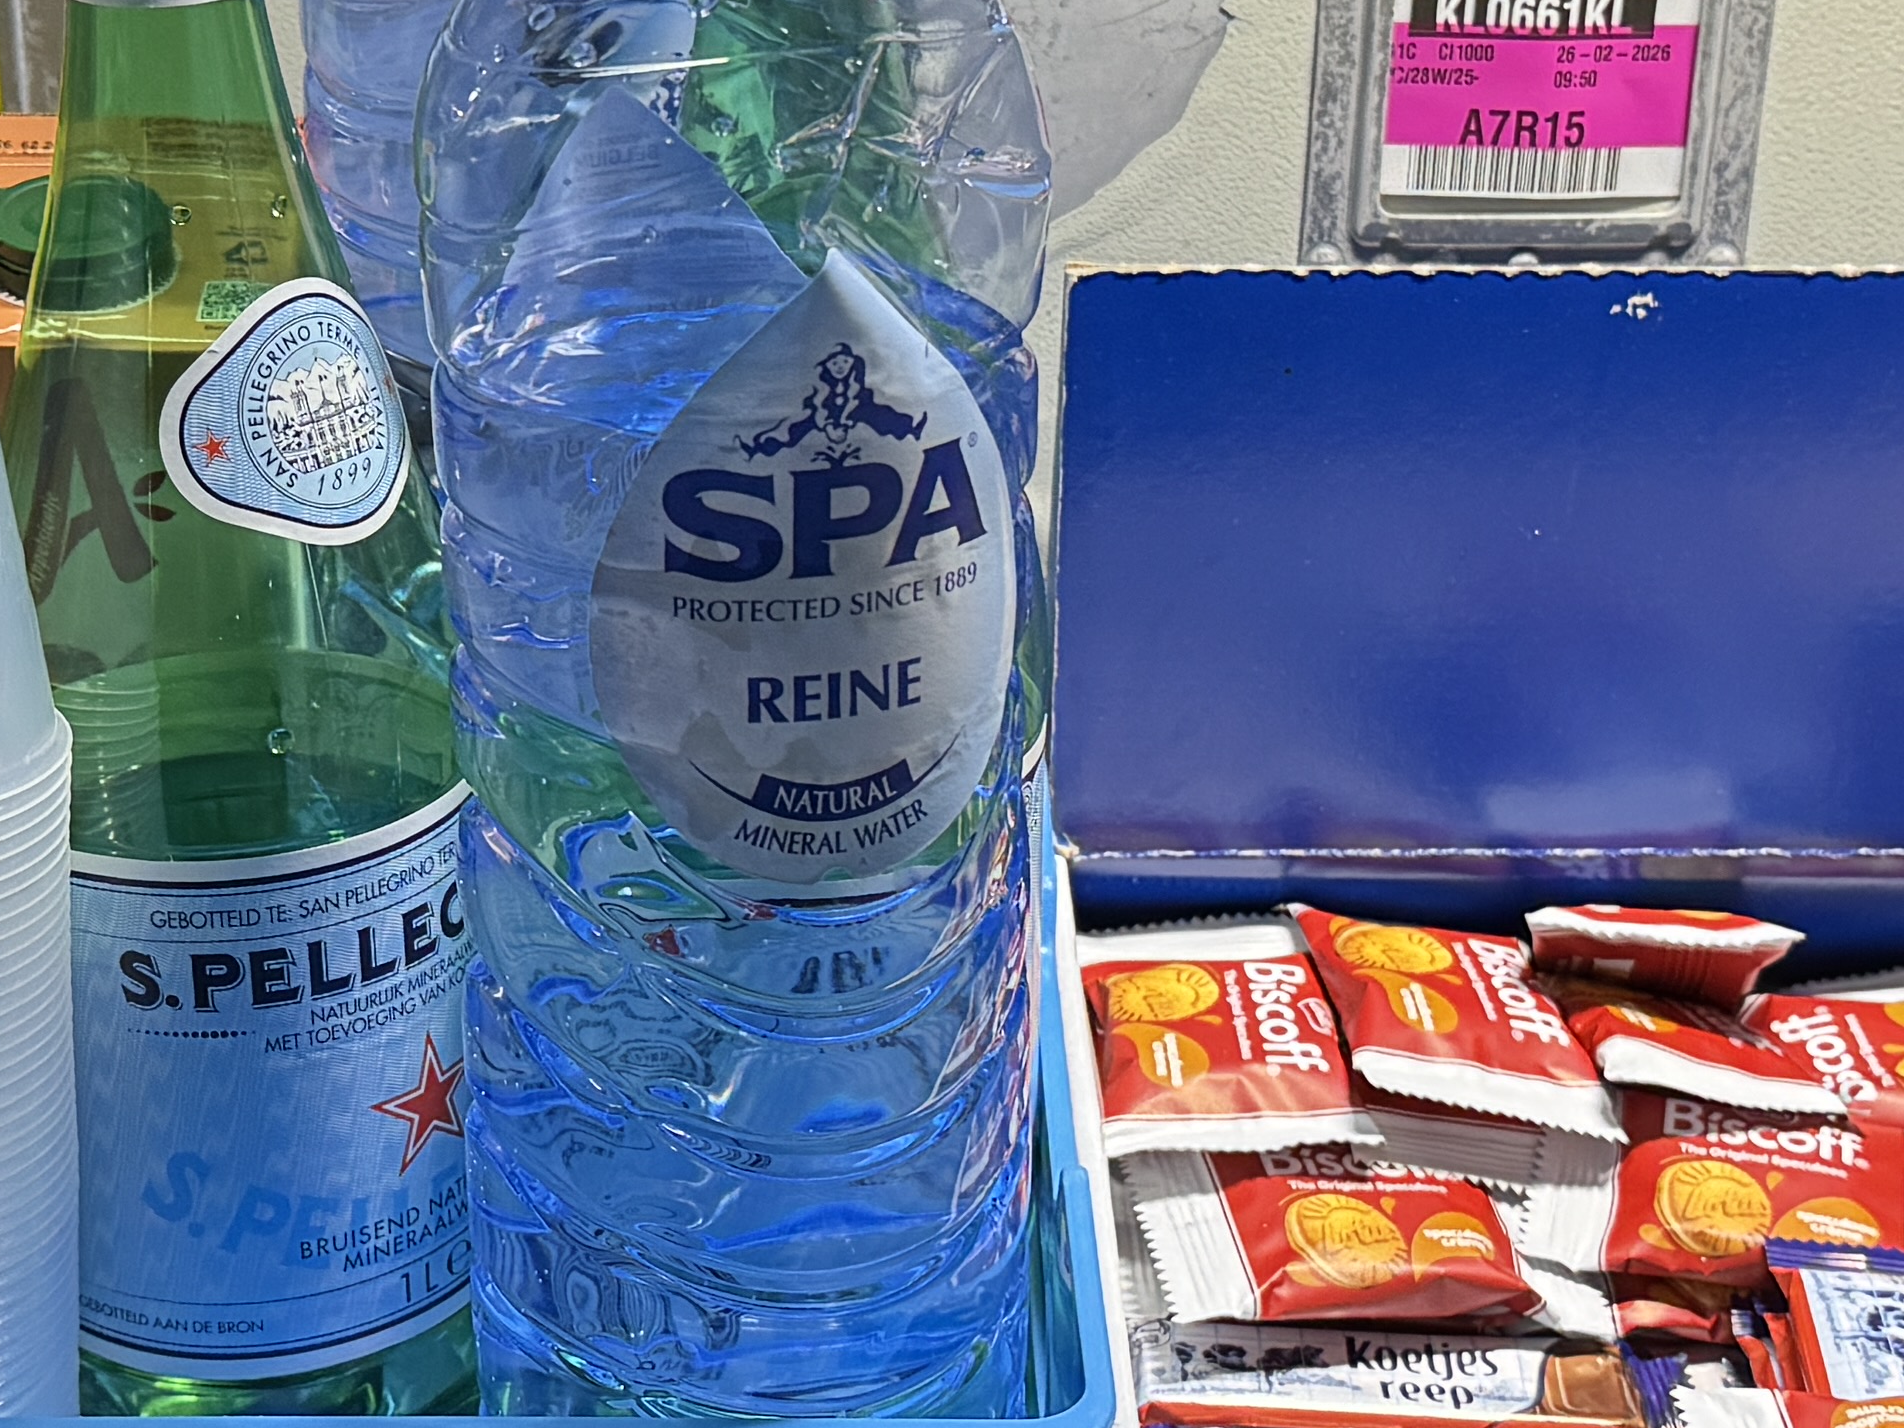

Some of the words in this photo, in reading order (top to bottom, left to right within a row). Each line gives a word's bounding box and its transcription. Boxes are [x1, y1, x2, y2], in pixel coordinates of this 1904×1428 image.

[1553, 70, 1598, 89] 09:50
[1458, 108, 1587, 150] A7R15
[317, 321, 361, 360] TERME
[247, 324, 311, 442] PELLEGRINO
[259, 452, 299, 489] SAN
[317, 457, 372, 496] 1899
[661, 437, 988, 584] SPA
[671, 596, 840, 623] PROTECTED
[849, 582, 925, 617] SINCE
[932, 562, 978, 597] 1889
[747, 657, 923, 725] REINE
[773, 774, 898, 816] NATURAL
[733, 818, 848, 858] MINERAL
[857, 798, 929, 851] WATER
[150, 907, 260, 930] GEBOTTELD
[265, 905, 293, 925] TE:
[298, 892, 341, 919] SAN
[344, 855, 435, 909] PELLEGRINO
[264, 1032, 300, 1054] MET
[308, 994, 417, 1047] TOEVOEGING
[419, 980, 446, 1006] VAN
[310, 977, 405, 1026] NATUURLIJK
[1243, 962, 1331, 1074] Biscoff
[1465, 938, 1572, 1049] Biscoff
[1663, 1097, 1864, 1162] Biscoff
[300, 1205, 421, 1260] BRUISEND
[152, 1316, 189, 1333] AAN
[193, 1319, 214, 1334] DE
[217, 1319, 265, 1334] BRON
[1345, 1334, 1499, 1380] Koetjes
[1380, 1377, 1475, 1411] reep
